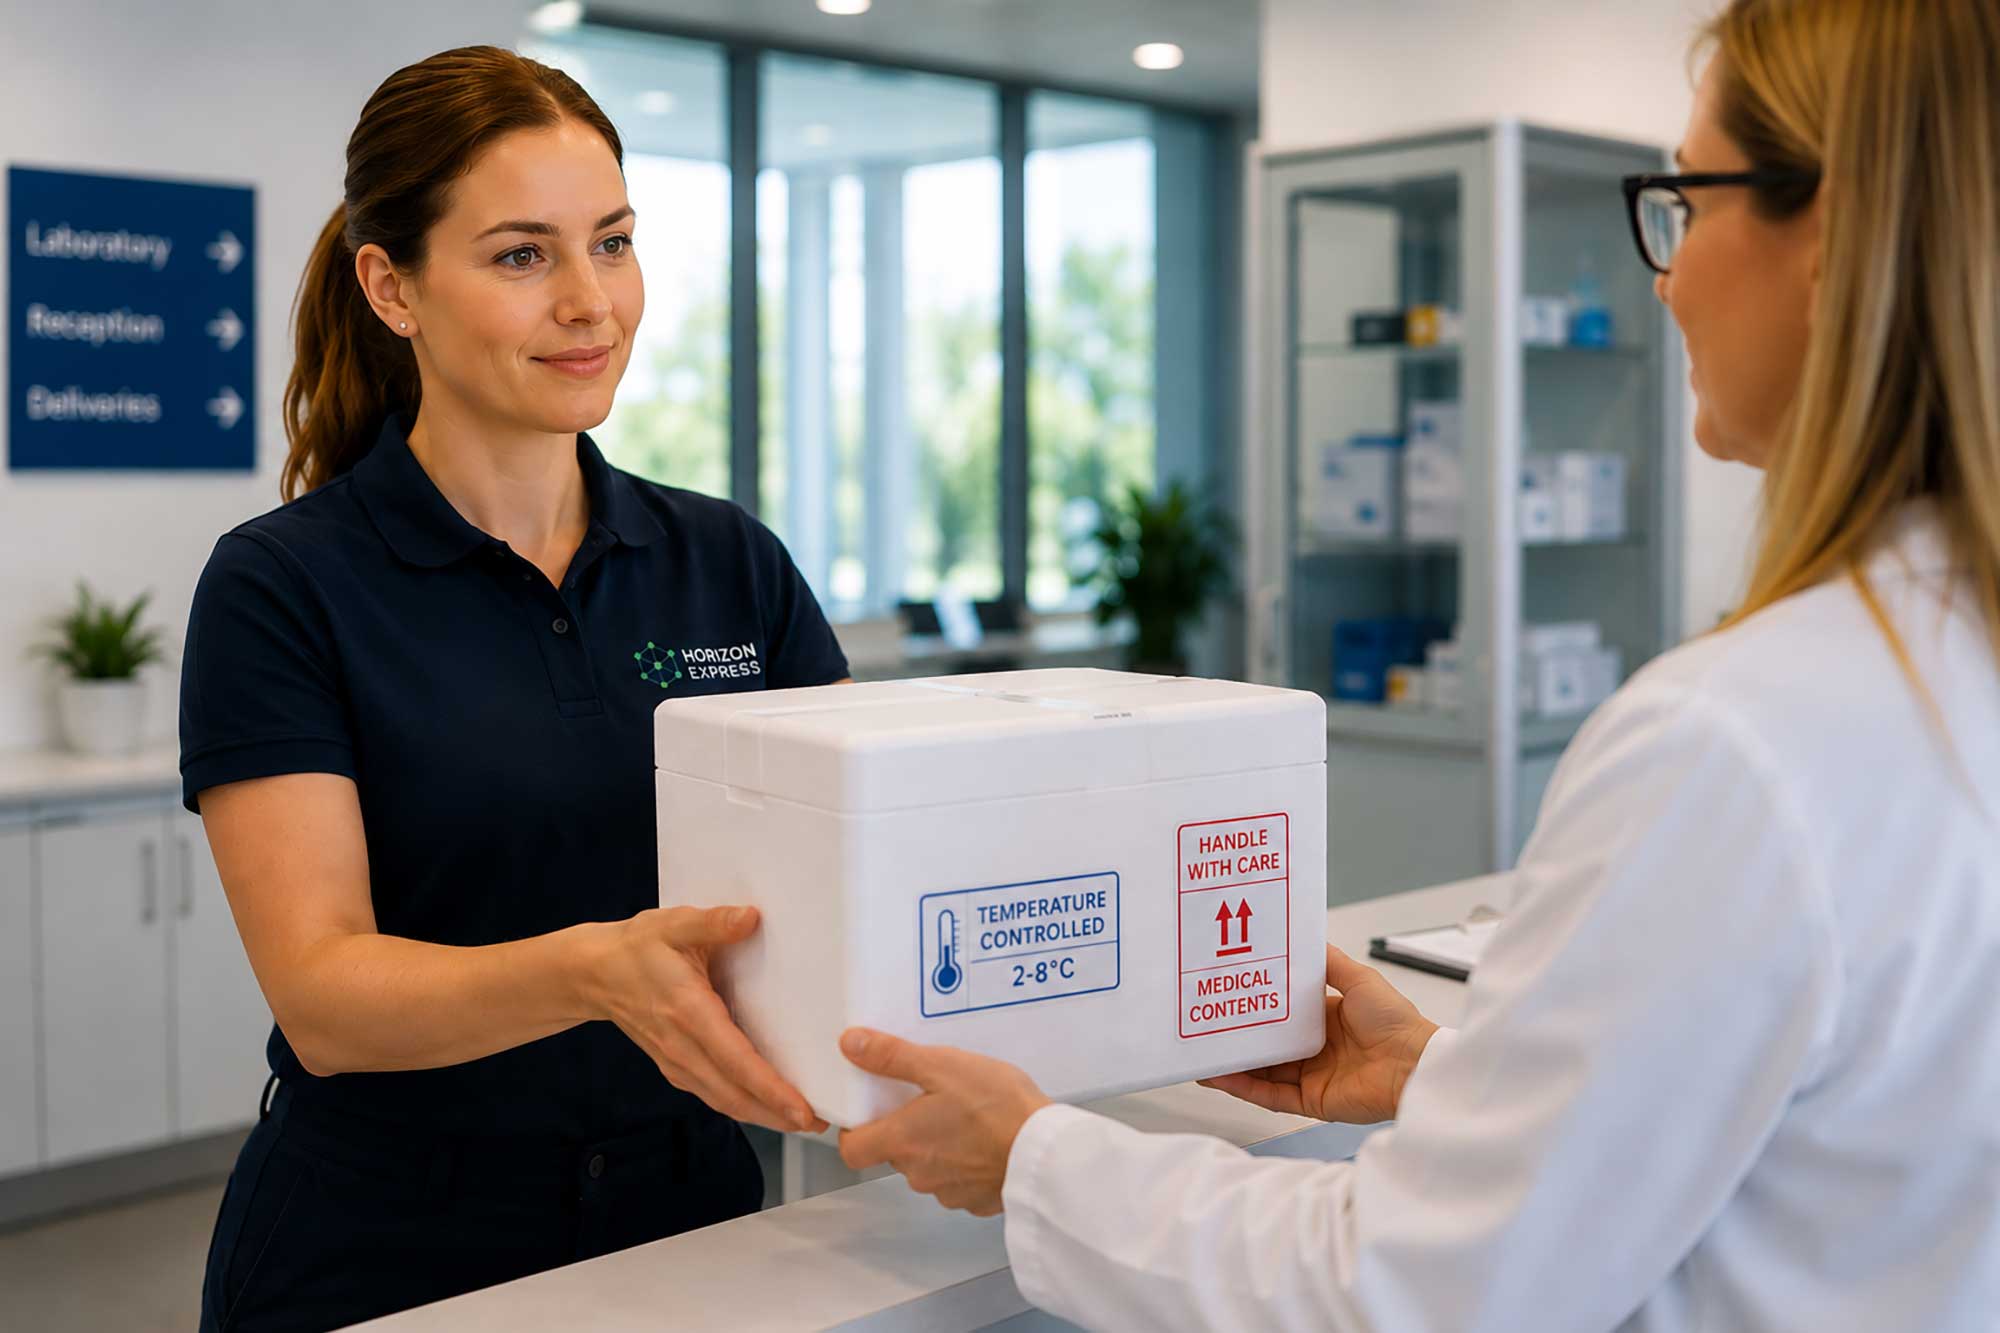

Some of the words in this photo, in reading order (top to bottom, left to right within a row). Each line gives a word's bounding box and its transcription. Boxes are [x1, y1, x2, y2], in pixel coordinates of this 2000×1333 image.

[26, 220, 171, 271] Laboratory
[27, 304, 163, 347] Reception
[27, 385, 161, 422] Deliveries
[681, 642, 757, 663] HORIZON
[688, 660, 761, 680] EXPRESS
[1199, 828, 1268, 854] HANDLE
[1187, 859, 1232, 881] WITH
[1237, 852, 1280, 875] CARE
[977, 890, 1107, 925] TEMPERATURE
[980, 916, 1105, 951] CONTROLLED
[1012, 956, 1076, 988] 2-8°C
[1197, 968, 1273, 998] MEDICAL
[1189, 991, 1279, 1023] CONTENTS
